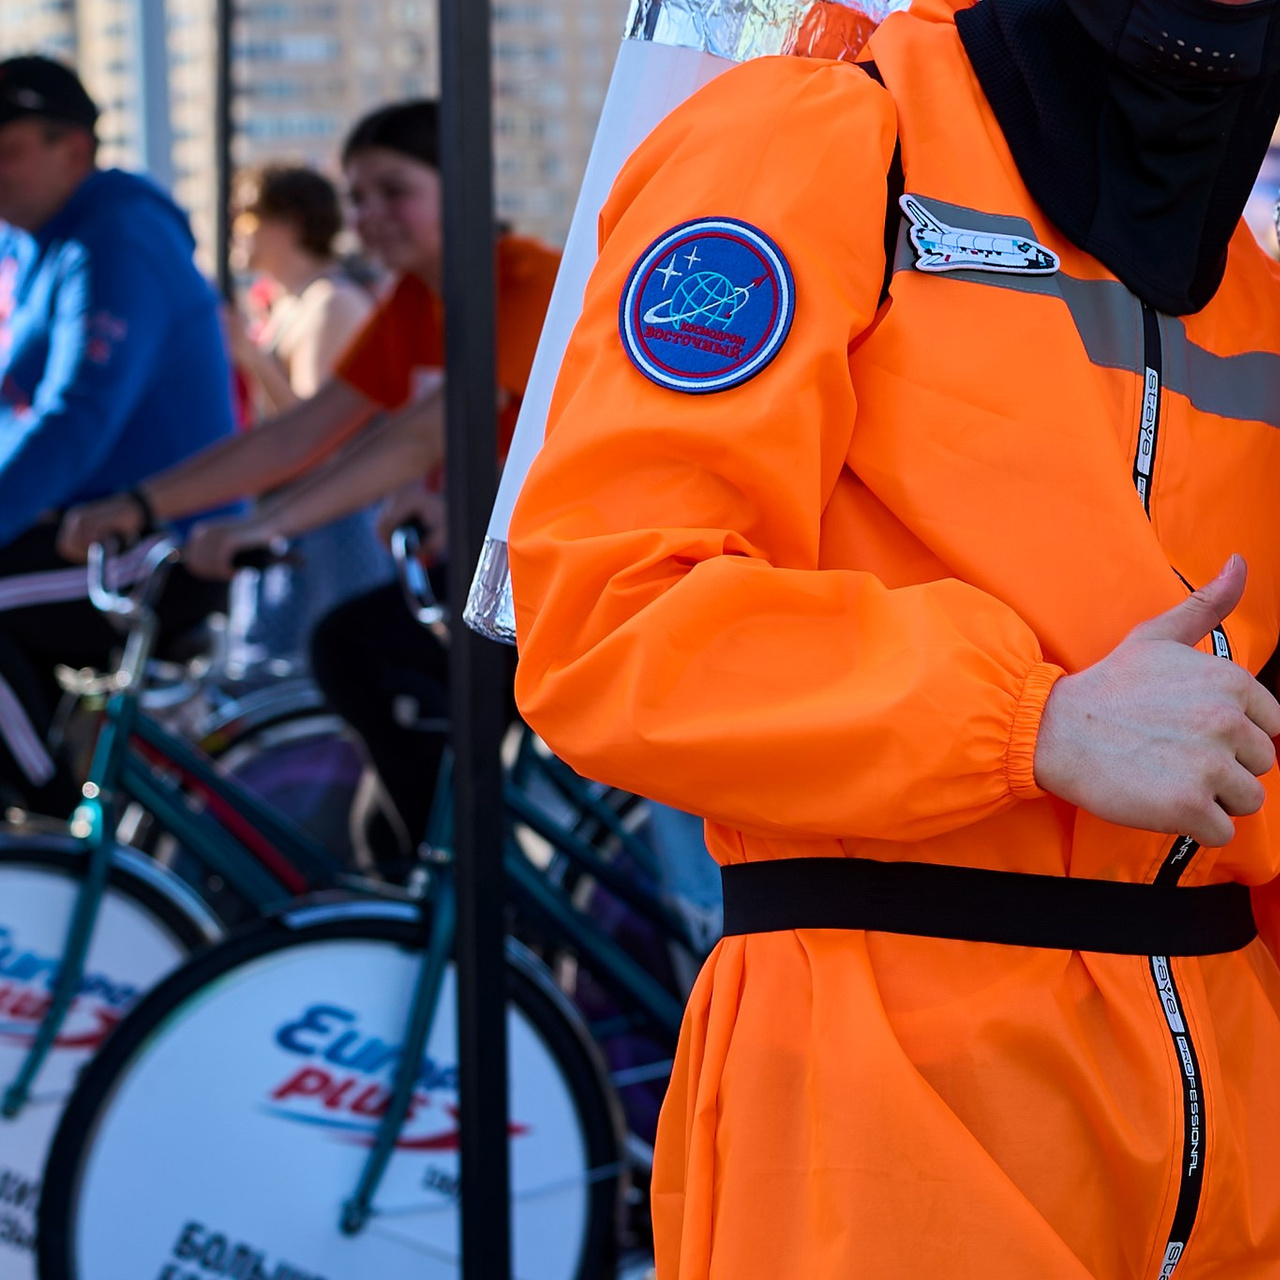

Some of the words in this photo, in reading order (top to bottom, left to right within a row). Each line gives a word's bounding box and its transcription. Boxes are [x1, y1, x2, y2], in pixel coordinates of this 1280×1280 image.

[644, 325, 743, 360] ВОСТОЧНЫЙ
[680, 321, 746, 346] КОСМОДРОМ
[1179, 1037, 1200, 1177] PROFESSIONAL
